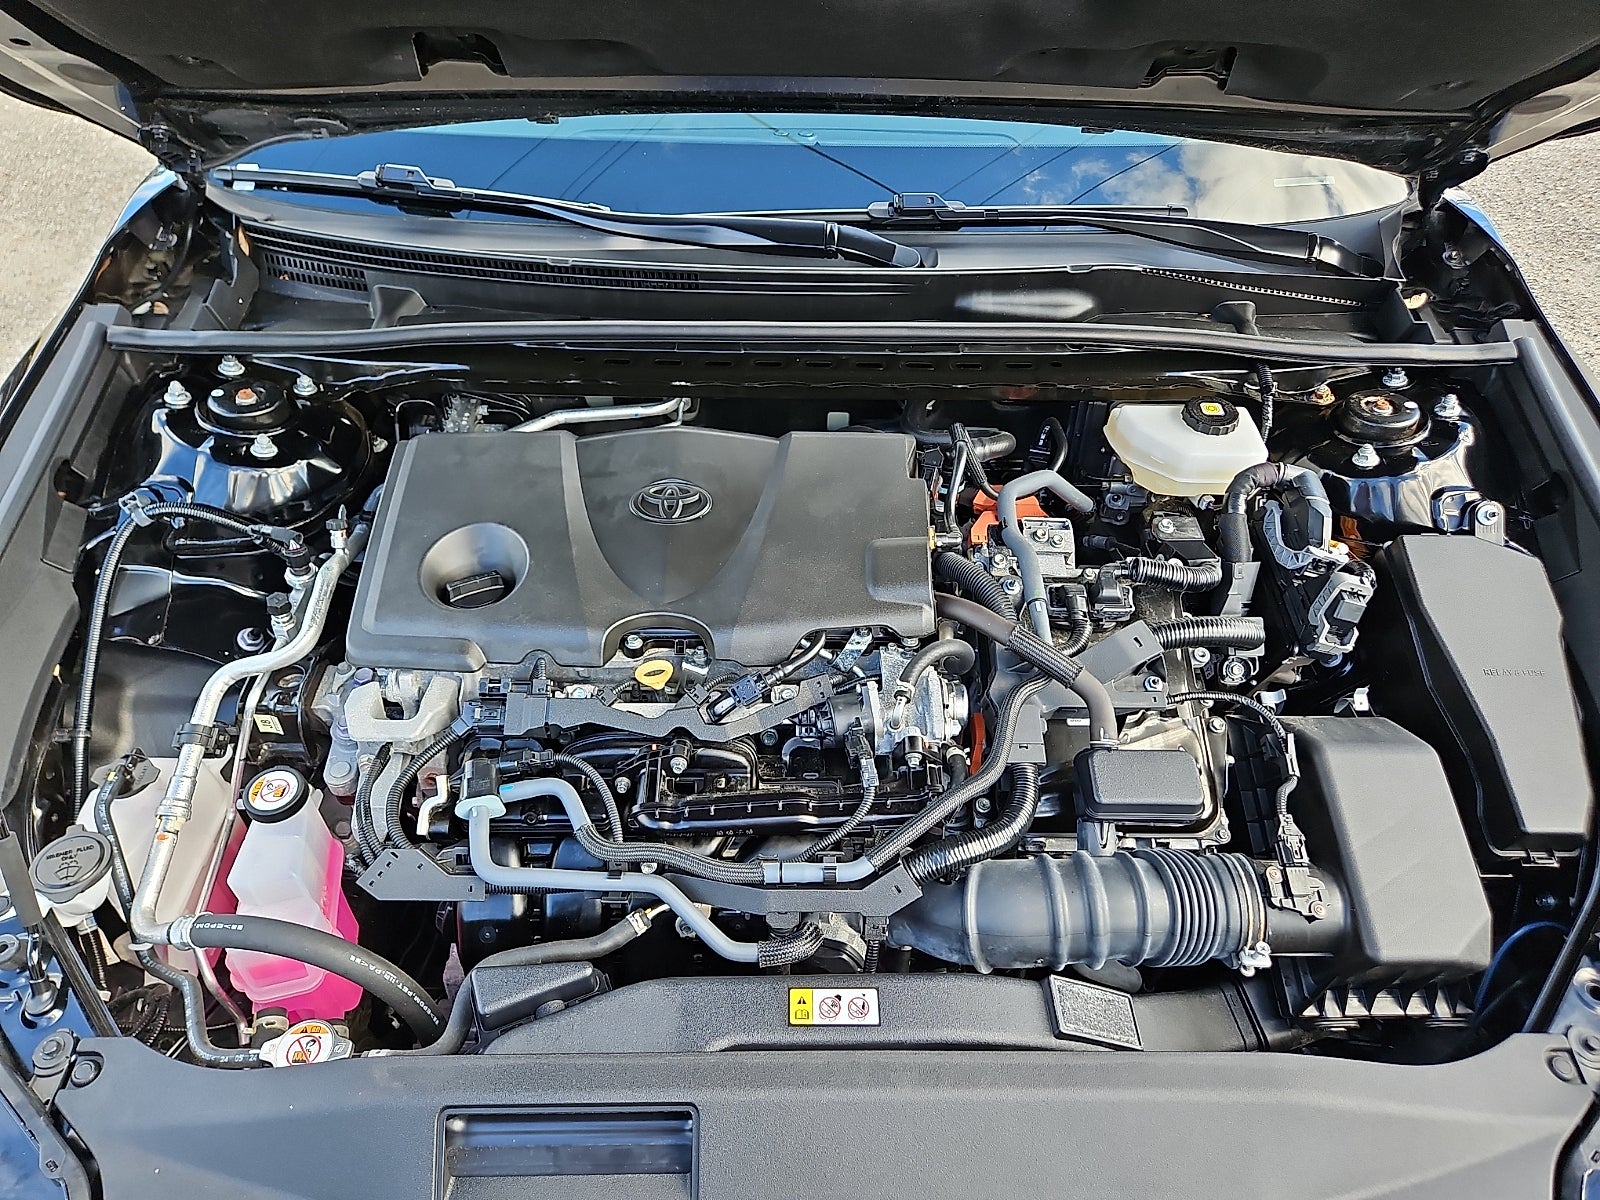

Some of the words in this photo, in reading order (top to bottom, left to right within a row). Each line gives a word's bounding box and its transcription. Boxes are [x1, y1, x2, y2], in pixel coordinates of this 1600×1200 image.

[1482, 667, 1512, 677] RELAY
[1521, 669, 1545, 677] FUSE
[76, 844, 95, 853] FLUID
[61, 854, 78, 862] ONLY
